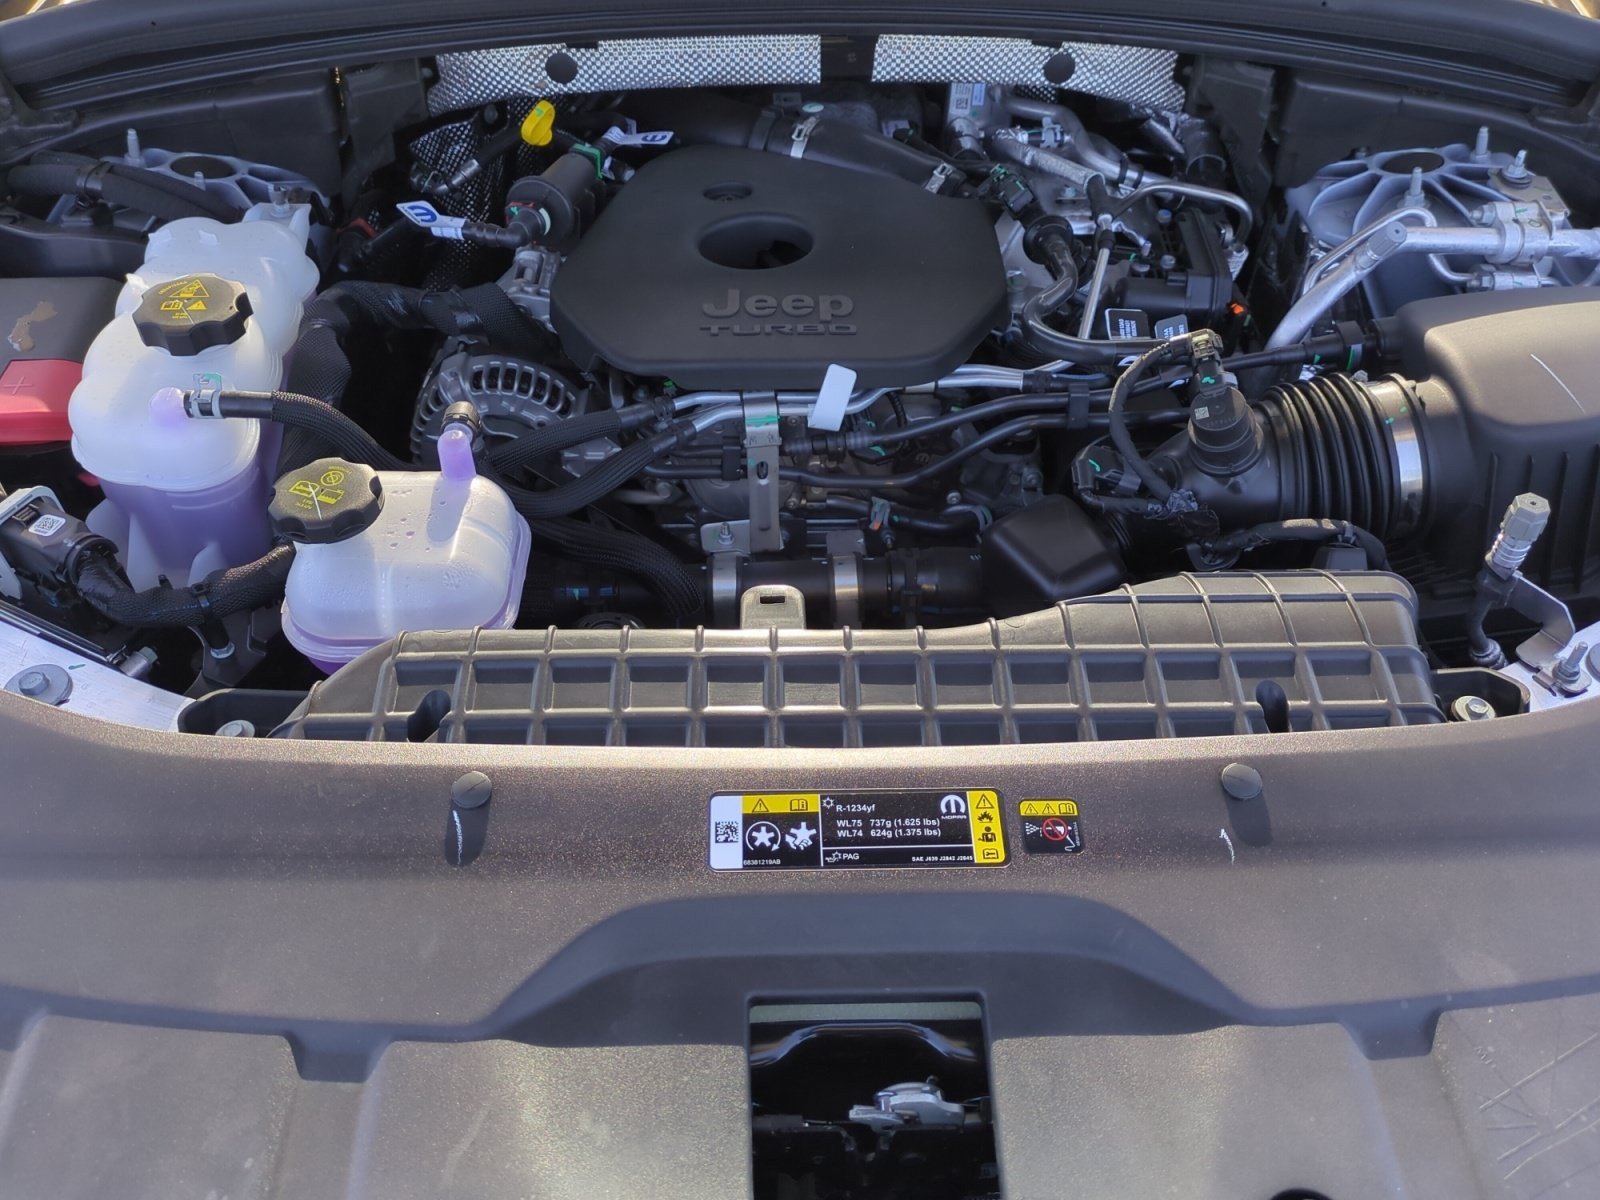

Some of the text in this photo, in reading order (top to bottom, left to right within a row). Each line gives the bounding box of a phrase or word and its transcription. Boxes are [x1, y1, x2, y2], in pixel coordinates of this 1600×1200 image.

[702, 288, 854, 323] Jeep
[700, 323, 857, 336] TURBO
[836, 804, 876, 813] R-1234yf
[837, 818, 940, 828] WL75 737g (1.625 lbs)
[870, 829, 892, 838] 624g
[895, 828, 921, 838] (1.375
[924, 828, 941, 837] lbs)
